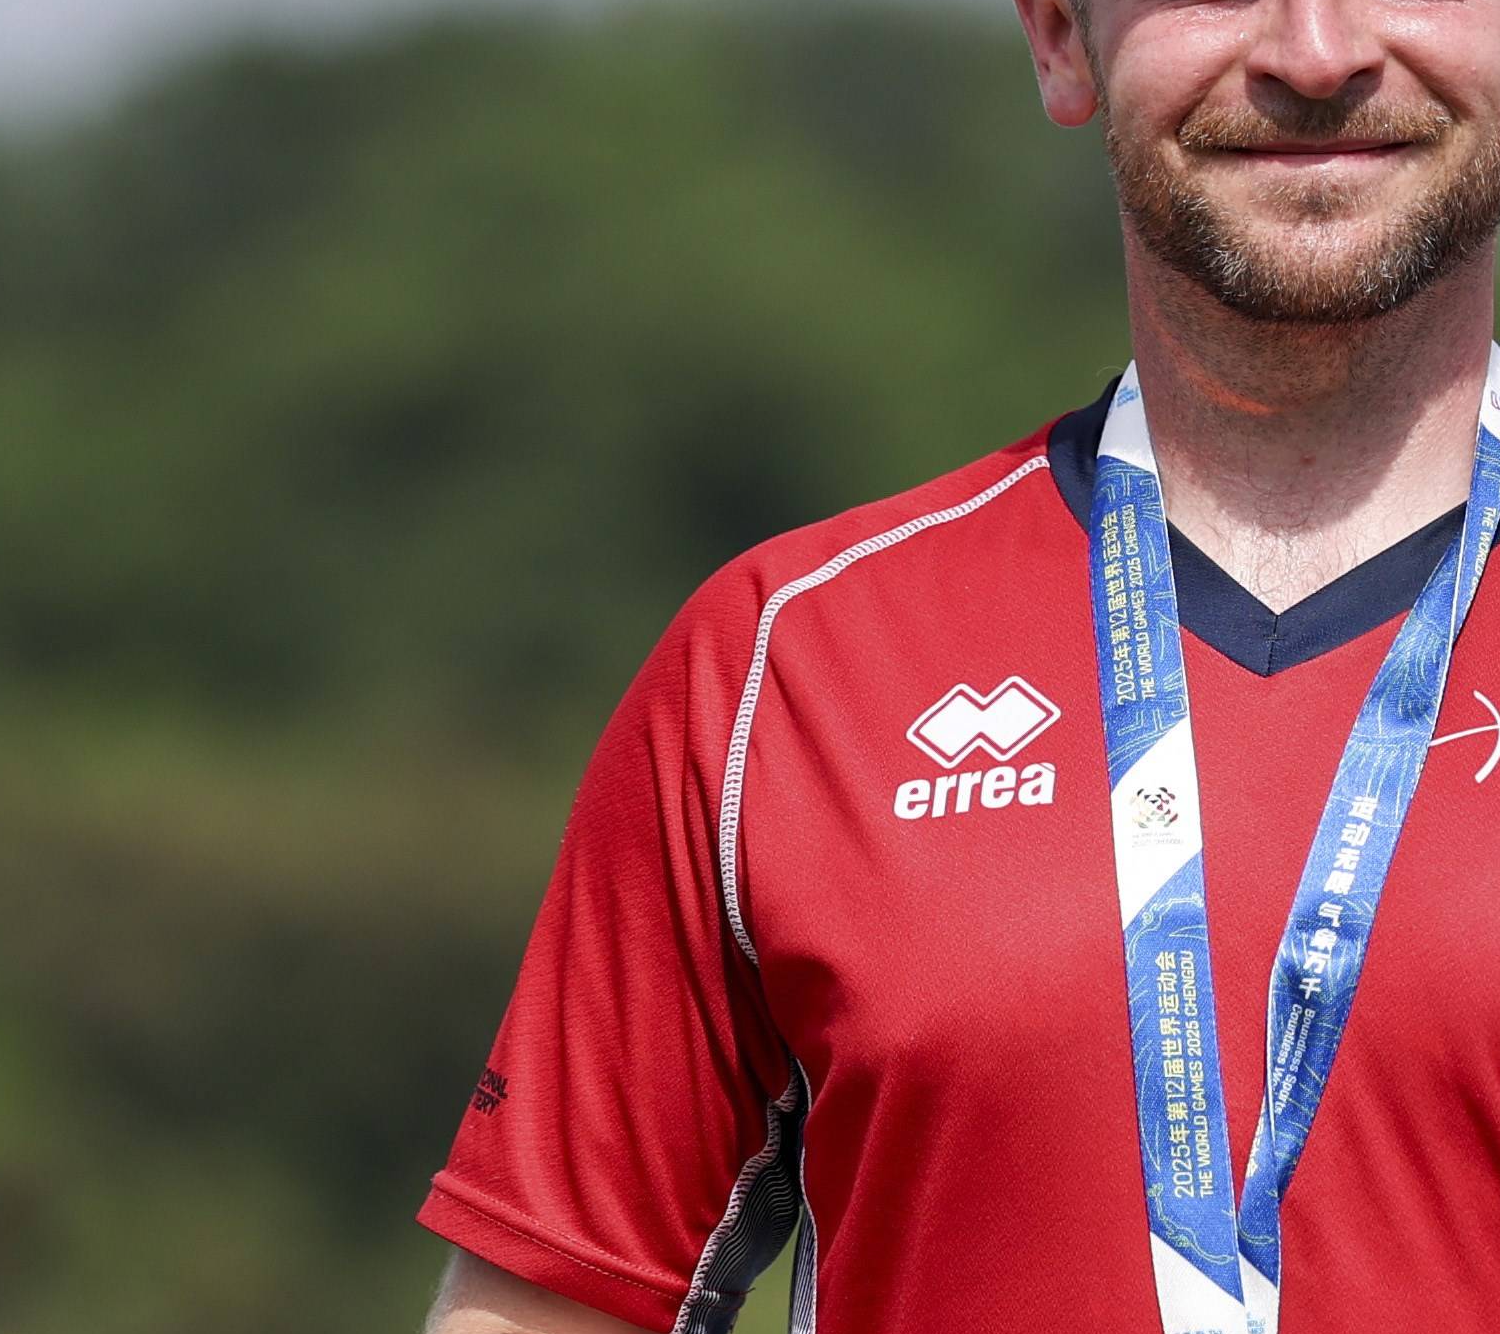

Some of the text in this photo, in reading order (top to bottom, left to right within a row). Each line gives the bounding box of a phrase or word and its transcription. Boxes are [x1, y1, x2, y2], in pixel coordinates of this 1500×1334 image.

[1127, 557, 1142, 588] 2025
[1131, 590, 1147, 630] GAMES
[1136, 632, 1152, 673] WORLD
[1141, 677, 1157, 699] THE
[1276, 1003, 1303, 1066] Countless
[1289, 1007, 1316, 1073] Boundless
[1155, 950, 1194, 1199] 2025年第12届世界运动会
[1181, 950, 1214, 1198] THE WORLD GAMES 2025 CHENGDU
[1275, 1073, 1297, 1115] Sports
